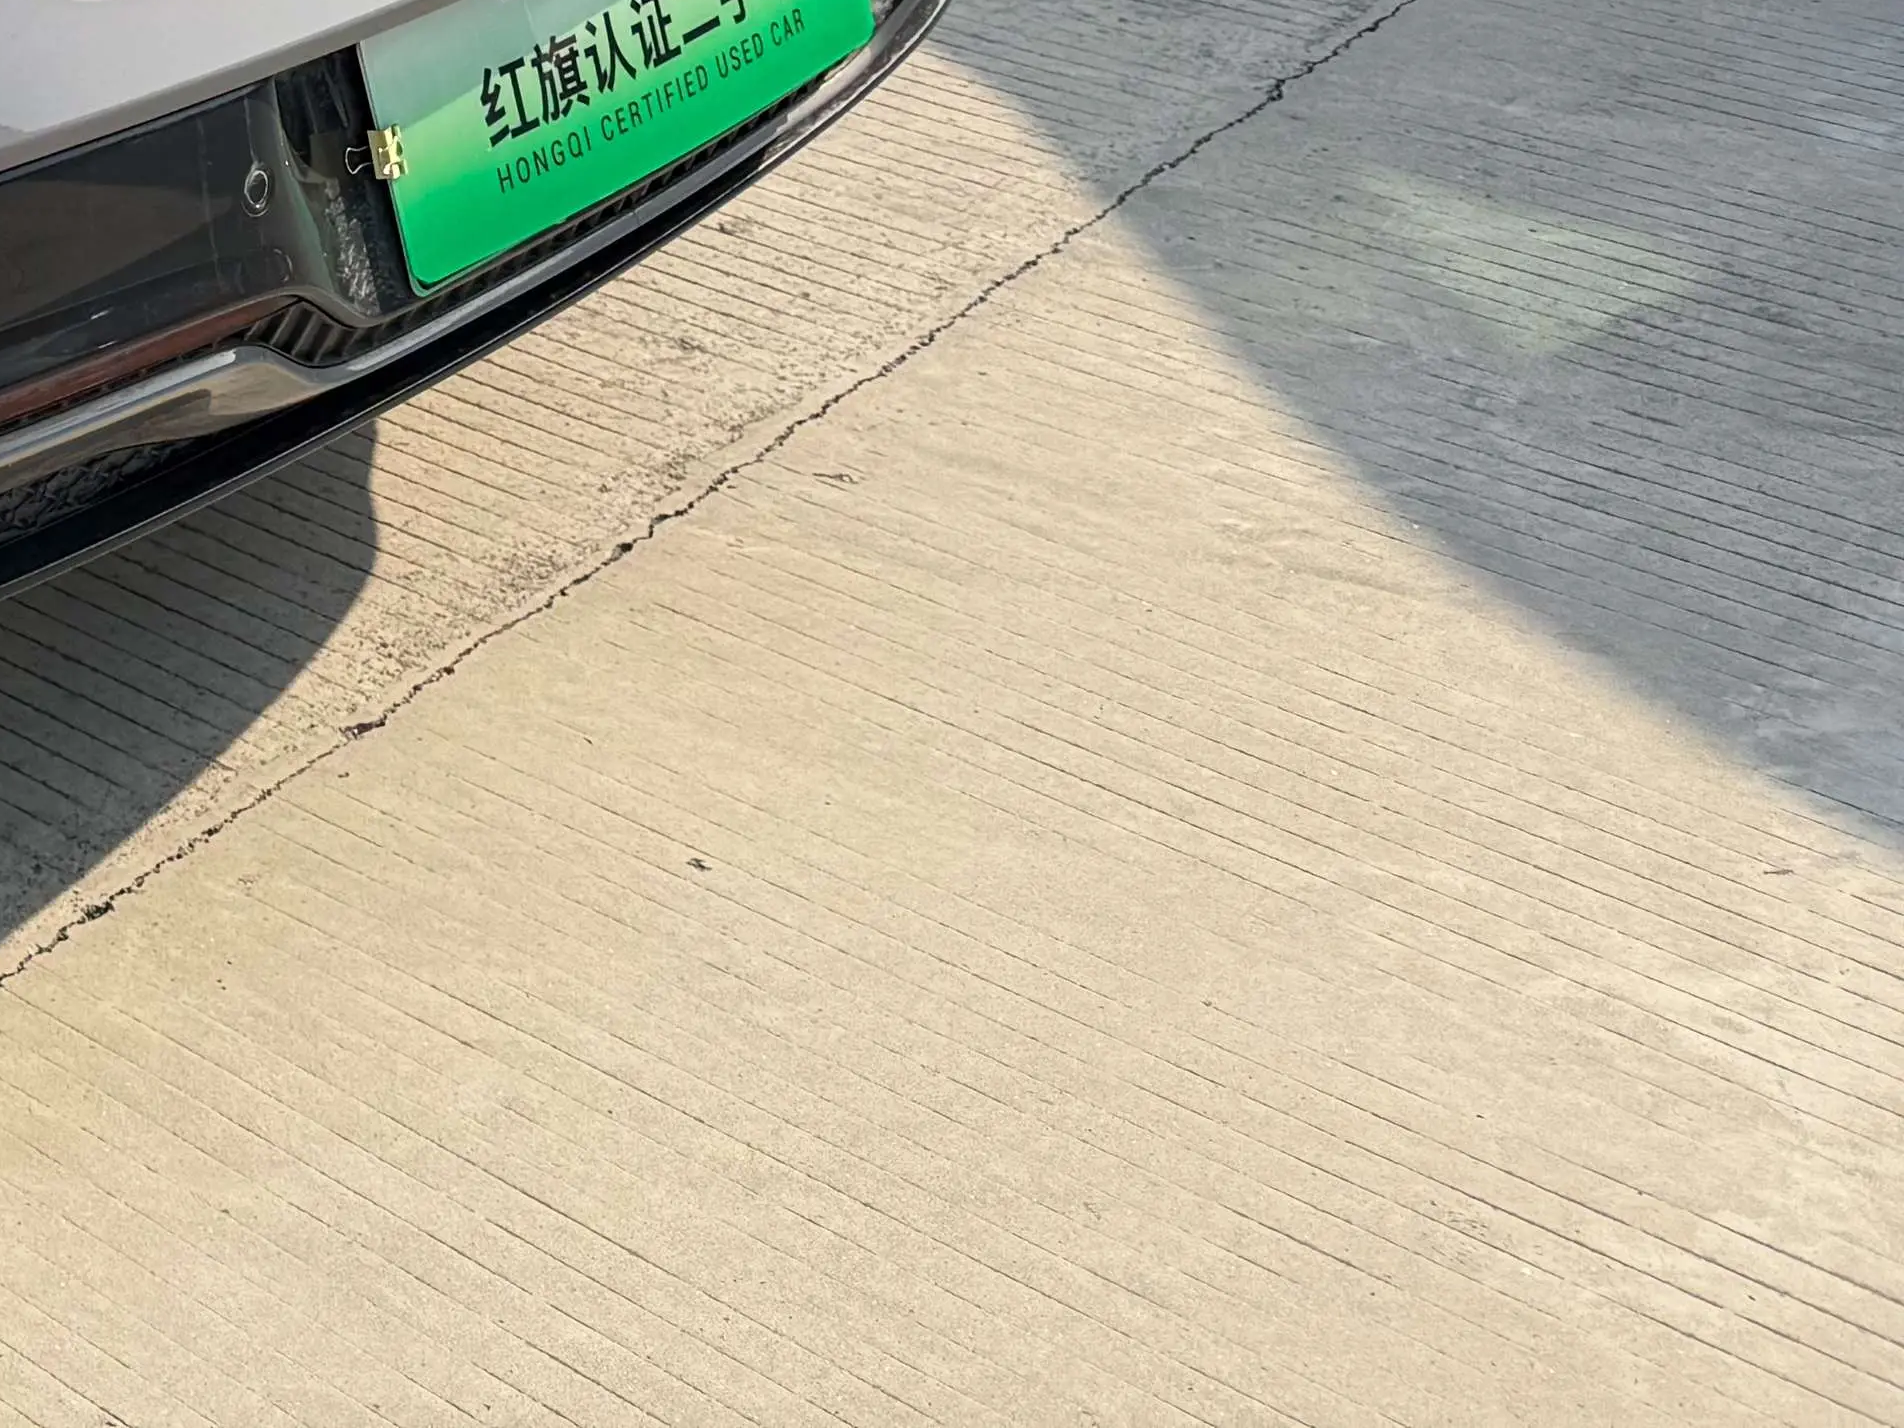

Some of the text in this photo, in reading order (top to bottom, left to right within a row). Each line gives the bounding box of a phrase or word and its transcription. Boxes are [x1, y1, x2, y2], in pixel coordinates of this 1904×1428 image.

[497, 8, 806, 193] HONGQI CERTIFIED USED CAR
